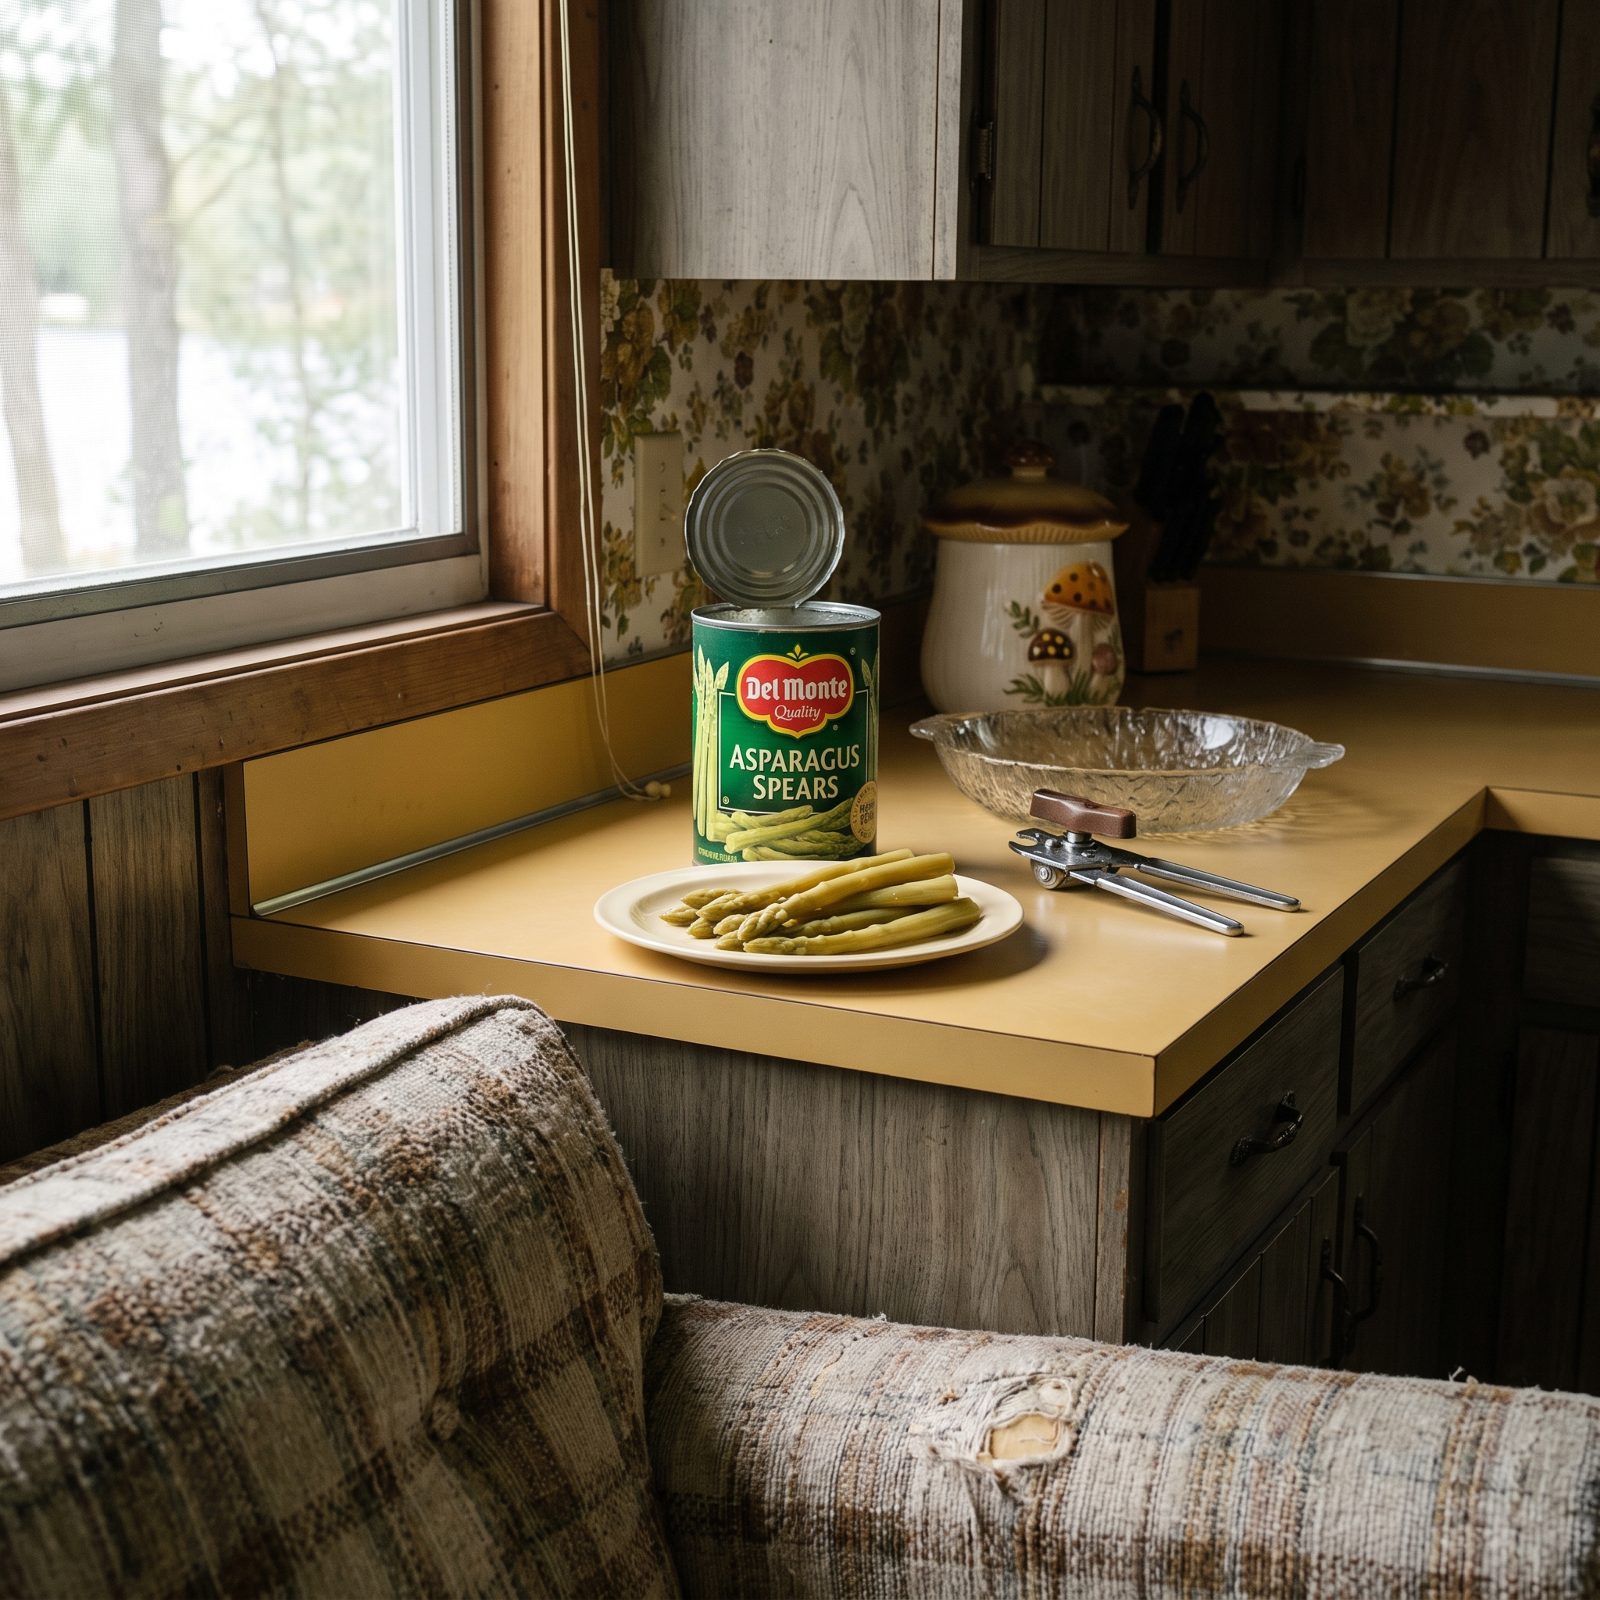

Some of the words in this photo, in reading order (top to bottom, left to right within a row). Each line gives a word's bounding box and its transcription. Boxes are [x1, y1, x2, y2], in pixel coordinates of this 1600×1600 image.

[746, 676, 780, 700] Del
[783, 677, 848, 701] Monte
[774, 705, 820, 721] Quality
[729, 744, 860, 773] ASPARAGUS
[753, 775, 839, 800] SPEARS
